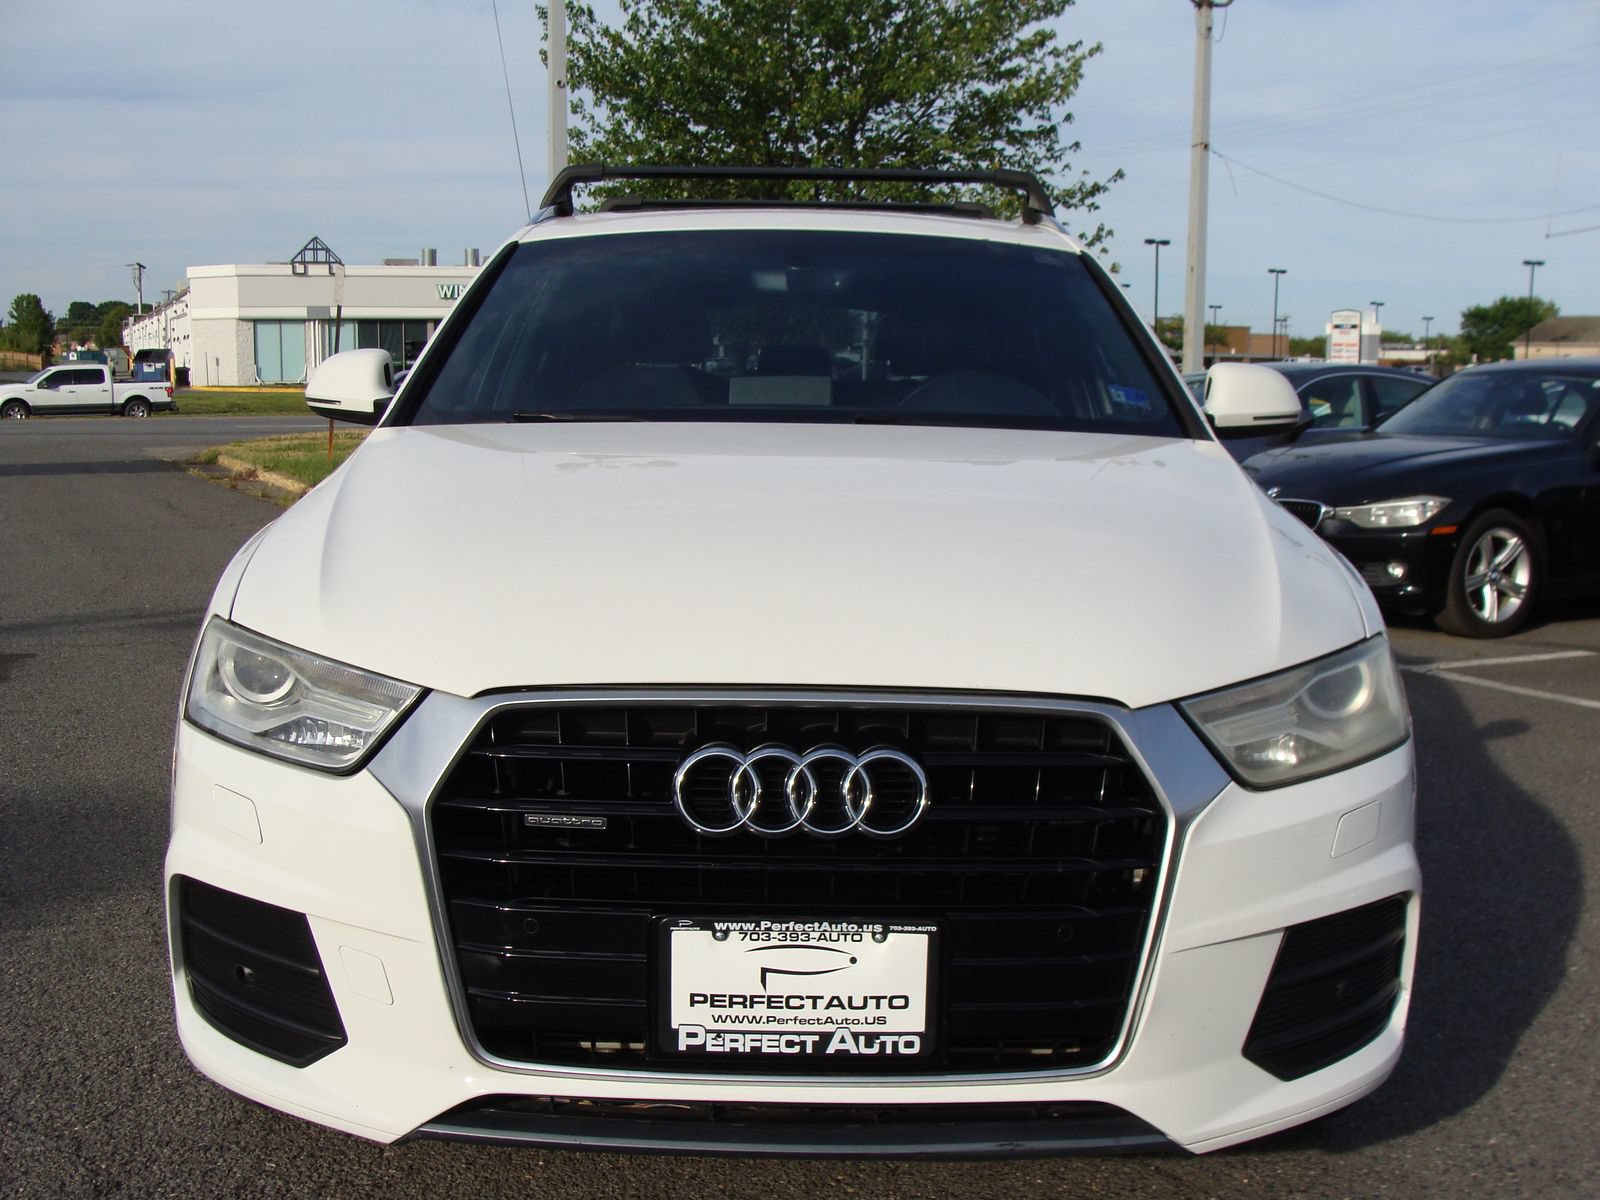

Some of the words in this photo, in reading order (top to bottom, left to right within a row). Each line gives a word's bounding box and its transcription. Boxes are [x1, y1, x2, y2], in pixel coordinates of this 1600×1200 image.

[528, 816, 603, 826] quattro
[714, 921, 883, 933] www.PerfectAuto.us
[738, 932, 863, 942] 703-393-AUTO
[689, 993, 910, 1010] PERFECTAUTO
[678, 1024, 820, 1054] PERFECT
[825, 1028, 921, 1055] AUTO
